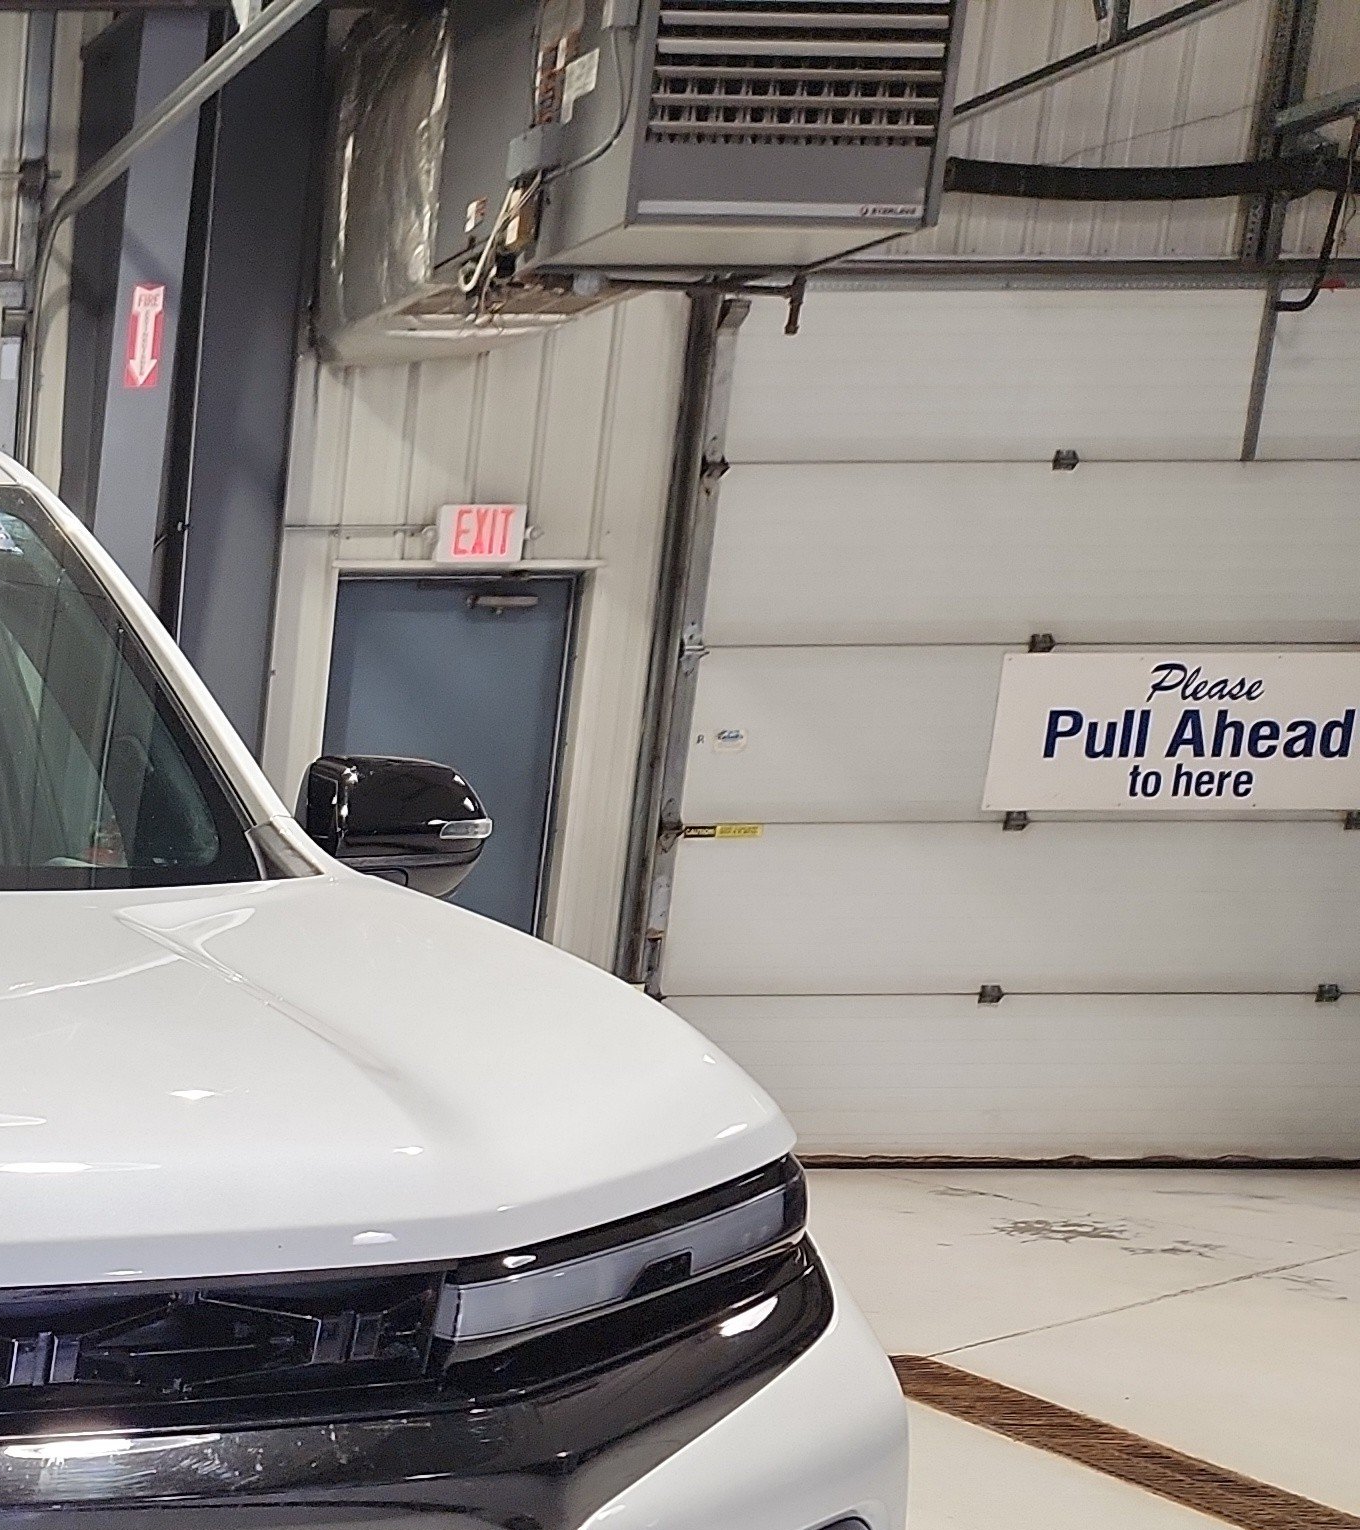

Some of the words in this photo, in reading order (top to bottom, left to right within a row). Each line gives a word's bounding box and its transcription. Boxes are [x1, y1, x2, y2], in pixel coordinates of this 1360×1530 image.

[453, 508, 515, 556] EXIT
[1146, 662, 1266, 703] Please
[1041, 708, 1152, 759] Pull
[1164, 707, 1357, 759] Ahead
[1128, 763, 1162, 798] to
[1171, 762, 1255, 798] here
